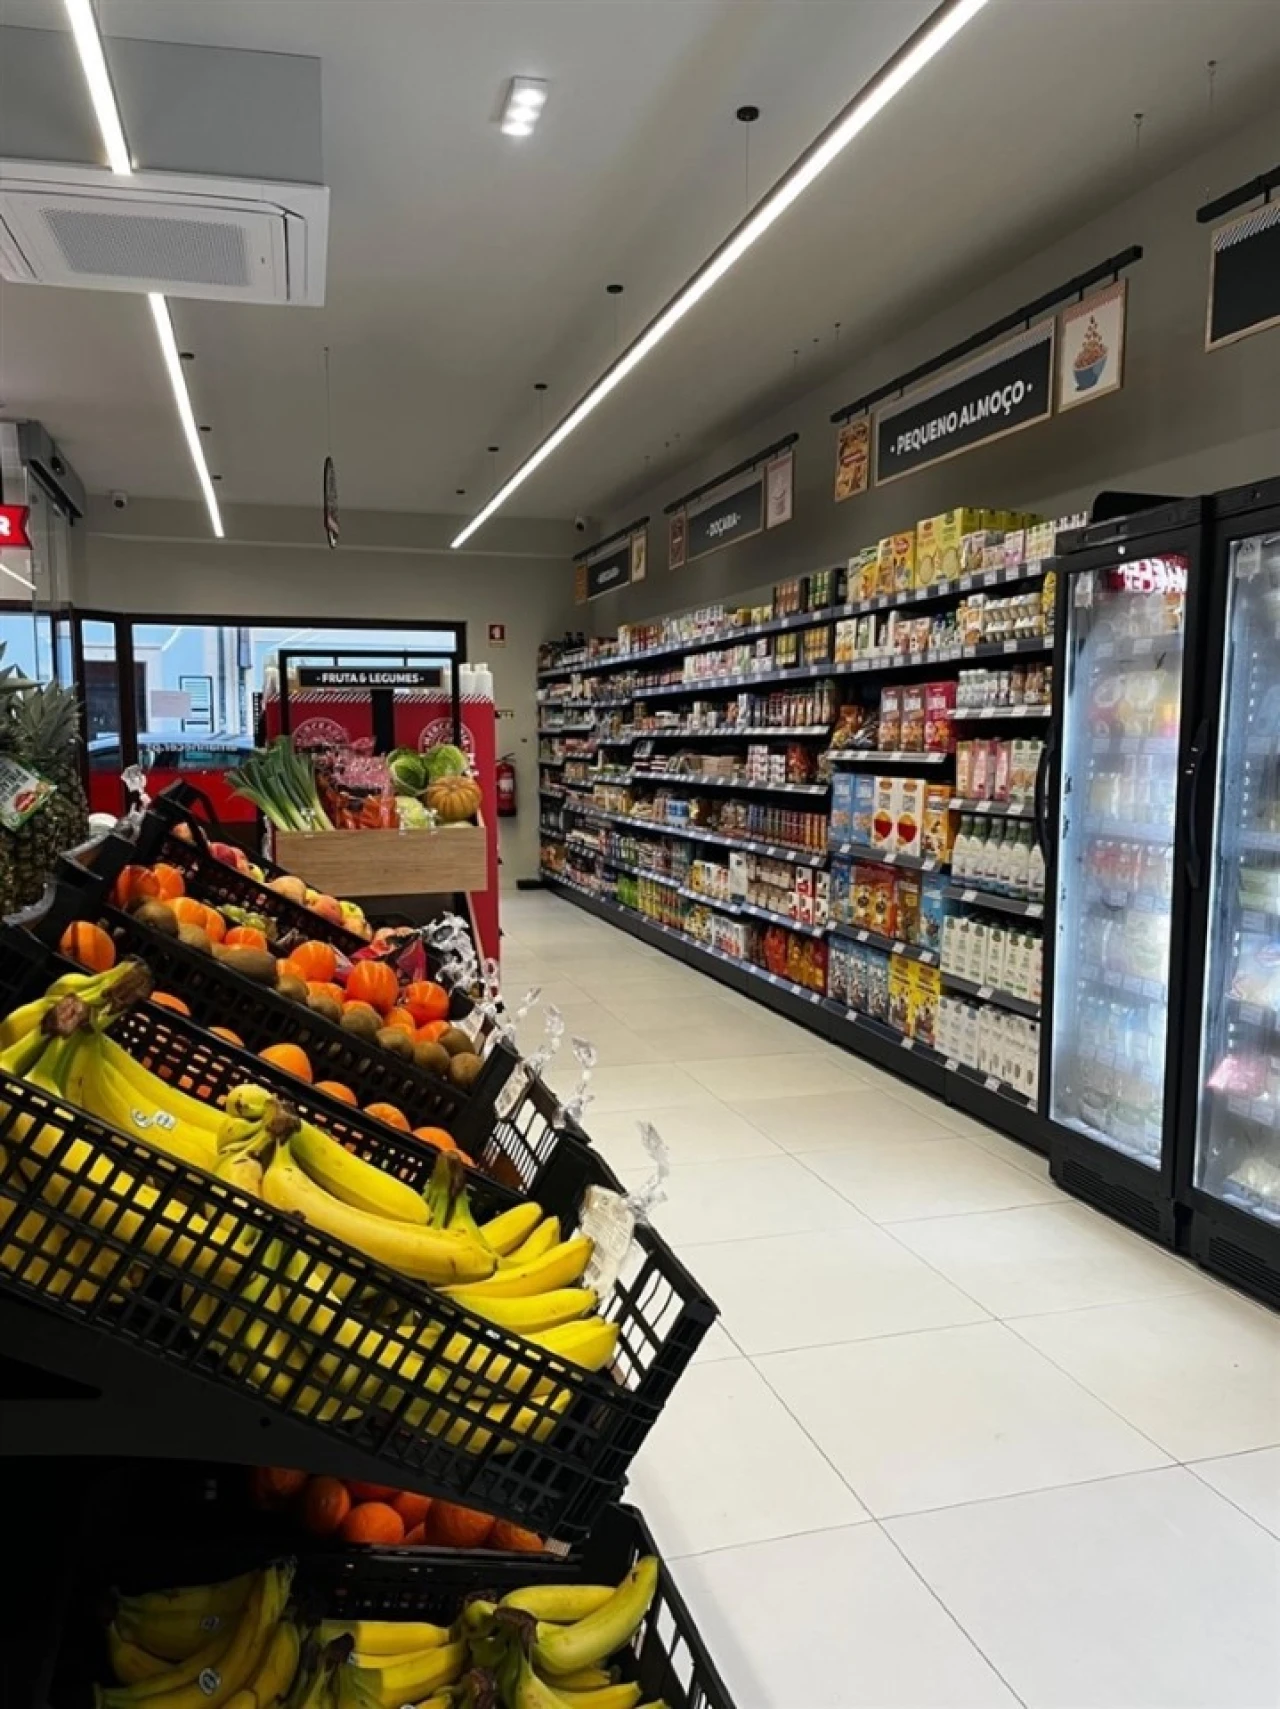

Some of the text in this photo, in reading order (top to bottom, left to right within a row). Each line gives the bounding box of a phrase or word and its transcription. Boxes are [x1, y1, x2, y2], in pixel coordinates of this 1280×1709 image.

[896, 380, 1025, 455] PEQUENO ALMOÇO
[321, 672, 419, 684] FRUTA & LEGUMES
